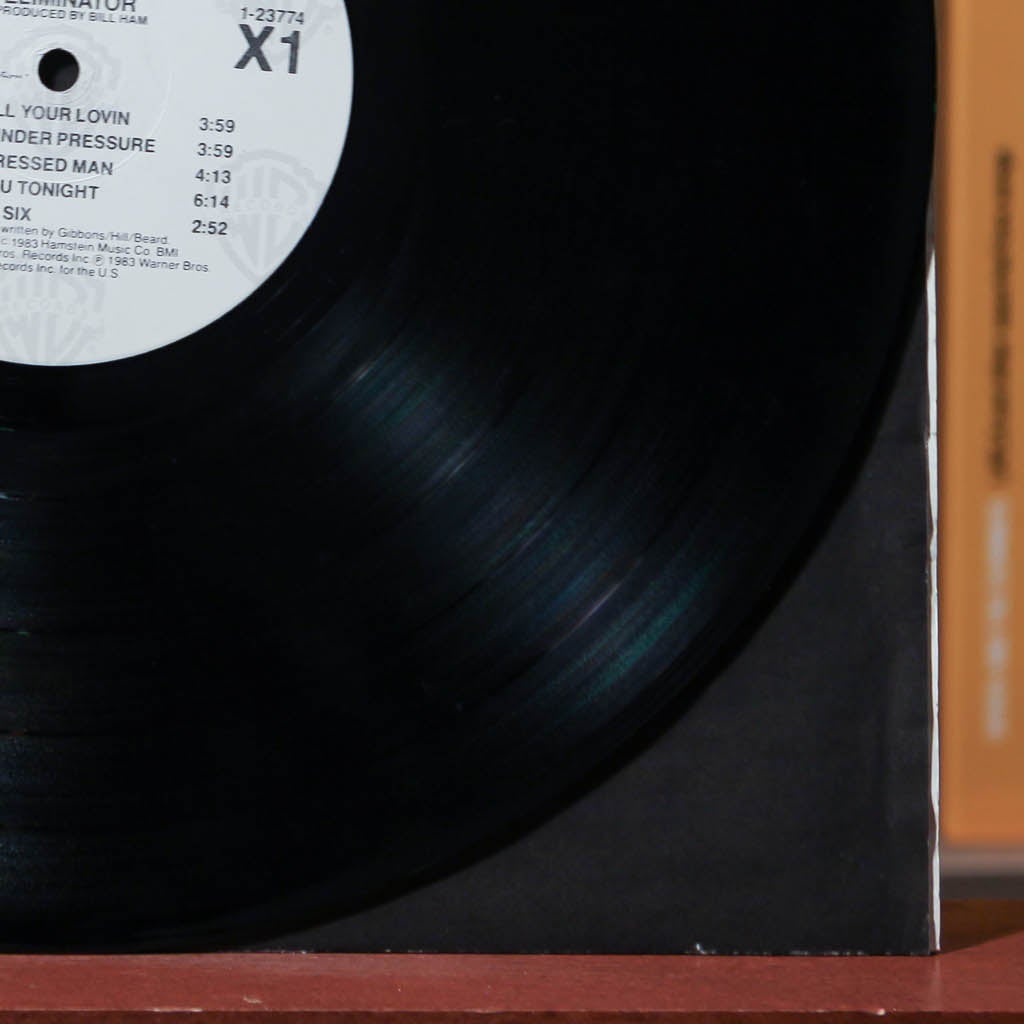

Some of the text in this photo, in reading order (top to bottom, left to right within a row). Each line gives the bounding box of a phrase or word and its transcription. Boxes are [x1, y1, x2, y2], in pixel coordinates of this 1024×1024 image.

[70, 10, 86, 20] BY
[89, 12, 116, 23] BILL
[119, 14, 148, 25] HAM
[240, 7, 305, 25] 1-23774
[234, 23, 301, 74] X1
[21, 104, 71, 122] YOUR
[76, 108, 130, 126] LOVIN
[199, 117, 235, 133] 3:59
[57, 132, 156, 153] PRESSURE
[197, 142, 234, 158] 3:59
[72, 159, 113, 176] MAN
[195, 168, 231, 184] 4:13
[17, 180, 100, 200] TONIGHT
[193, 193, 230, 208] 6:14
[1, 224, 38, 236] written
[42, 227, 54, 238] by
[2, 206, 32, 222] SIX
[191, 219, 228, 236] 2:52
[41, 238, 94, 252] Hamstein
[97, 243, 130, 255] Music
[156, 247, 179, 258] BMI
[22, 250, 68, 263] Records
[109, 256, 135, 267] 1983
[139, 258, 180, 270] Warner
[60, 265, 74, 275] for
[77, 266, 96, 277] the
